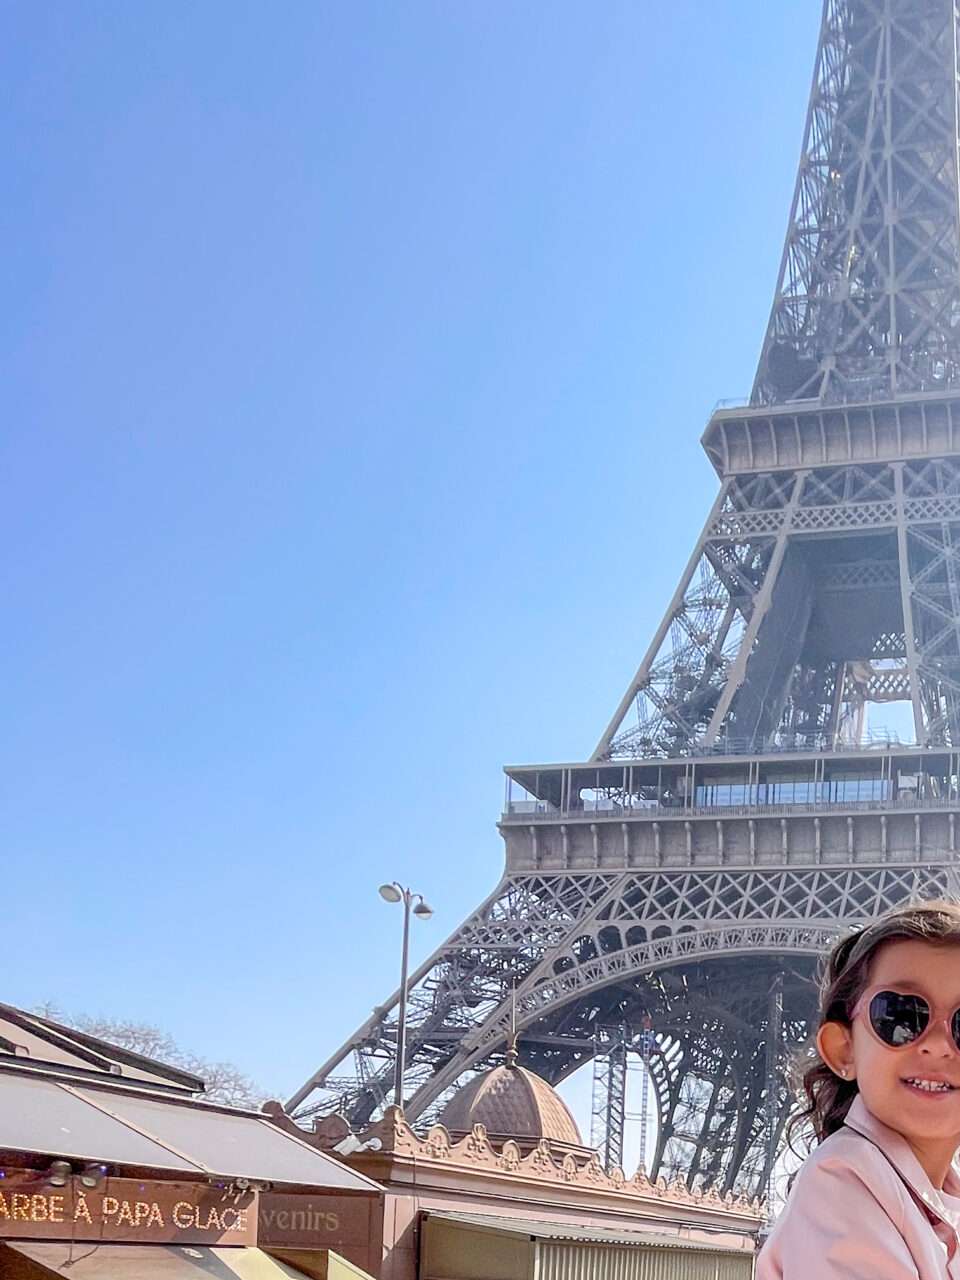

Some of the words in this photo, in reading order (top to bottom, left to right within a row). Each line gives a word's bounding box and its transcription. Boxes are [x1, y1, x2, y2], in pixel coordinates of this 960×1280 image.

[73, 1190, 93, 1224] À
[102, 1196, 165, 1228] PAPA
[172, 1201, 248, 1232] GLACE
[261, 1203, 339, 1232] venirs
